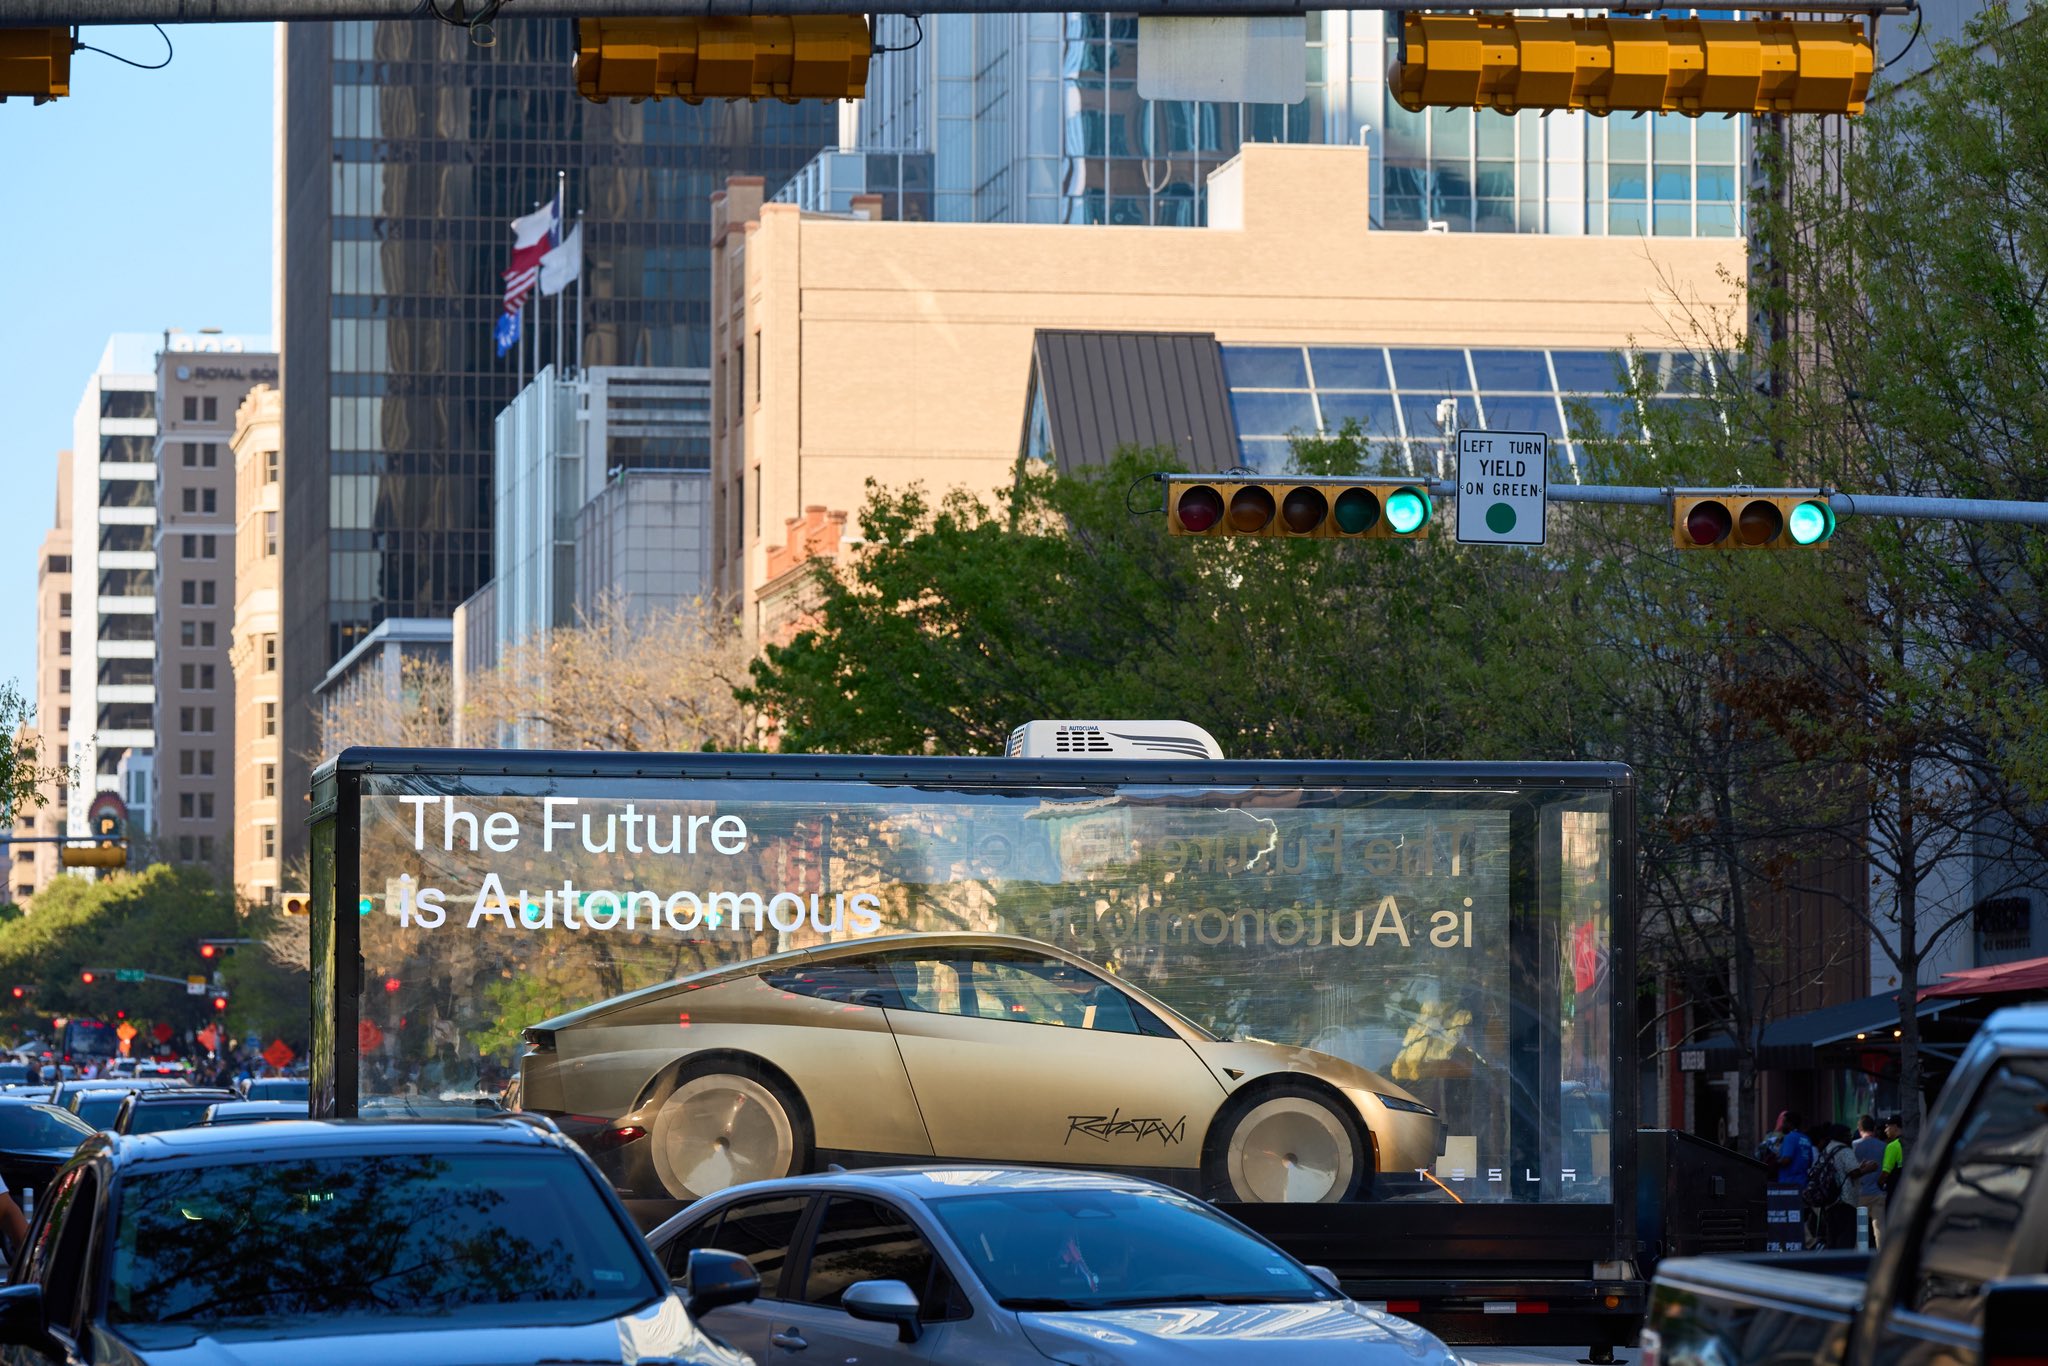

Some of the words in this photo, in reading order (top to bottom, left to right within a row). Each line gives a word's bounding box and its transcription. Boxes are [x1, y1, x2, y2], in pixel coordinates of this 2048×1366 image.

[1463, 439, 1493, 453] LEFT
[1509, 441, 1541, 455] TURN
[1479, 459, 1526, 478] YIELD
[1466, 481, 1484, 495] ON
[1493, 482, 1538, 497] GREEN
[399, 794, 520, 853] The
[543, 796, 748, 855] Future
[399, 872, 447, 928] is
[466, 871, 882, 934] Autonomous
[1414, 1168, 1577, 1182] TESLA
